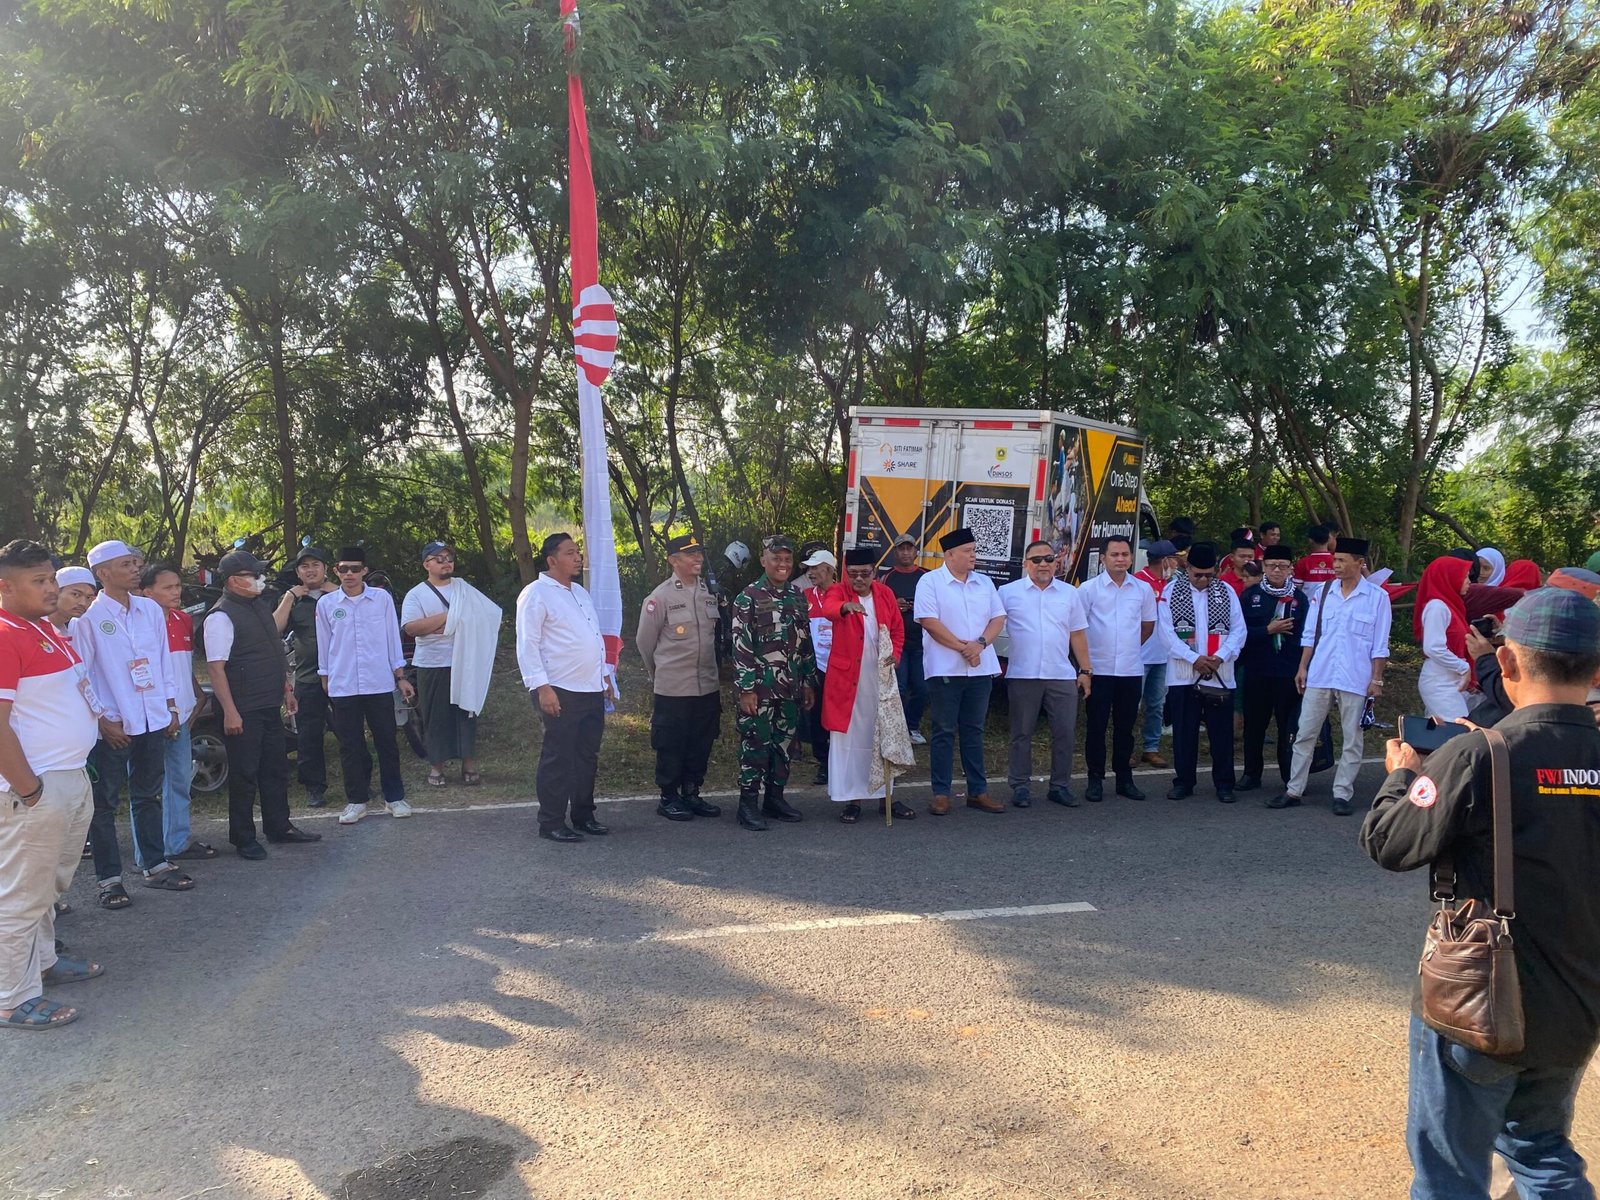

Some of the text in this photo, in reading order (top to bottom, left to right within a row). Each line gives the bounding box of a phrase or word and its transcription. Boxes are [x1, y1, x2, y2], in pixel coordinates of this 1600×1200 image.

[1111, 470, 1138, 494] One Step
[1115, 496, 1136, 512] Ahead
[1091, 520, 1134, 542] for Humanity
[1536, 769, 1600, 785] FWJINDO
[1539, 786, 1569, 794] Bersama
